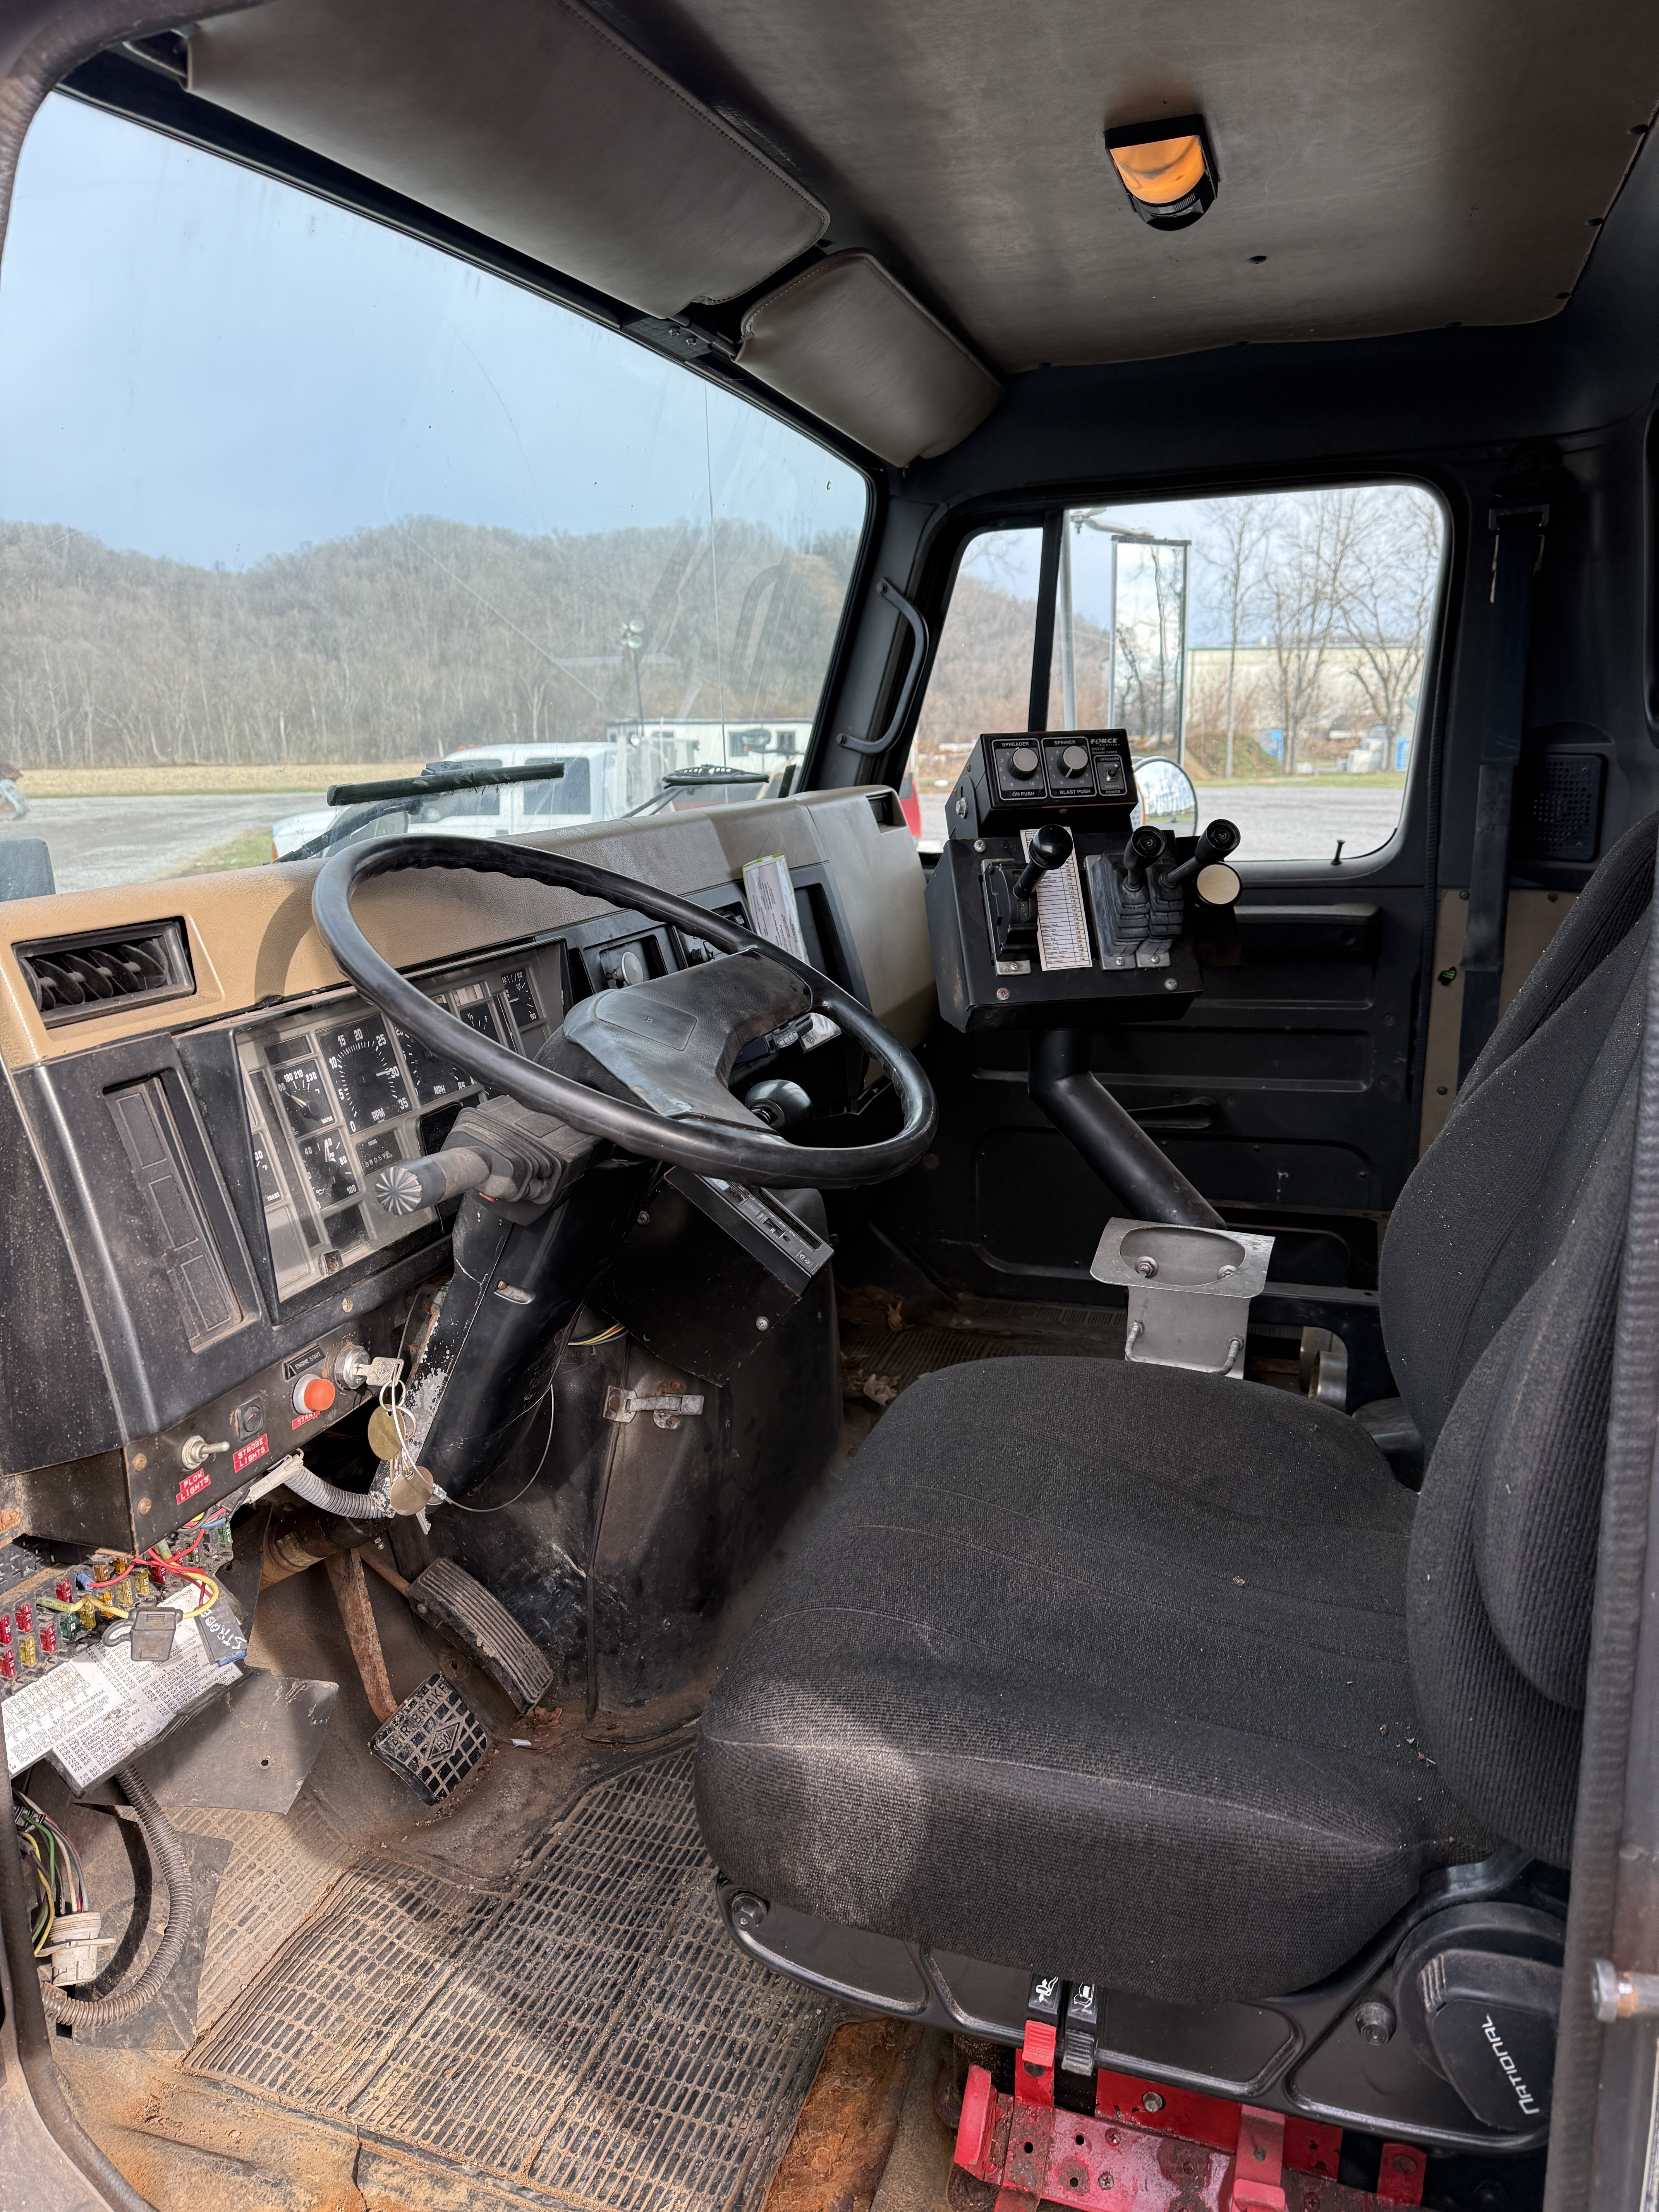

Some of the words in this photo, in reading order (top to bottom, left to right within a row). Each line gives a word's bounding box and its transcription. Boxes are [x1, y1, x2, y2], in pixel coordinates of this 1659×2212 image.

[337, 1034, 346, 1047] 15
[353, 1028, 363, 1041] 20
[376, 1034, 386, 1046] 25
[329, 1056, 338, 1069] 10
[284, 1073, 294, 1083] 180
[294, 1069, 304, 1079] 210
[306, 1072, 317, 1082] 230
[389, 1066, 400, 1079] 30
[433, 1085, 446, 1095] MPH
[458, 1081, 465, 1090] 85
[338, 1089, 344, 1100] 5
[398, 1097, 409, 1110] 35
[371, 1108, 385, 1121] RPM
[350, 1121, 356, 1132] 0
[324, 1138, 332, 1147] 60
[305, 1146, 312, 1155] 40
[339, 1156, 347, 1165] 80
[347, 1184, 356, 1194] 100
[294, 1358, 309, 1369] ENGINE
[309, 1351, 321, 1362] START
[238, 1437, 264, 1460] STROBE
[239, 1446, 266, 1467] LIGHTS
[184, 1470, 202, 1488] PLOW
[180, 1476, 209, 1501] LIGHTS
[138, 1674, 151, 1683] RADIO
[164, 1674, 183, 1688] ELECTRIC
[183, 1663, 199, 1675] WINDOW
[185, 1667, 202, 1680] RELEASE
[218, 1666, 234, 1678] MODULE
[161, 1673, 175, 1685] CELECT
[173, 1685, 190, 1698] DAYTIME
[57, 1712, 69, 1722] AUTO
[69, 1703, 82, 1714] RESET
[91, 1689, 105, 1700] BREAK
[65, 1735, 76, 1743] ACC
[76, 1723, 92, 1735] WSHLD
[119, 1697, 132, 1707] WASH
[79, 1730, 91, 1739] HEAT
[124, 1699, 137, 1709] RELAY
[389, 1726, 411, 1747] AIR
[411, 1683, 448, 1724] BRAKE
[84, 1735, 100, 1747] CARGO
[100, 1714, 131, 1736] LIGHT/TRAILER
[133, 1721, 146, 1731] PANEL
[148, 1727, 161, 1737] RELAY
[87, 1732, 113, 1751] RADIO/FUEL
[113, 1722, 128, 1733] METER
[90, 1743, 105, 1755] CIGAR
[104, 1731, 124, 1745] LIGHTER
[124, 1731, 139, 1742] METER
[436, 1731, 452, 1750] BW
[71, 1742, 81, 1750] BAT
[99, 1758, 109, 1766] FOG
[1482, 2014, 1540, 2114] NATIONAL
